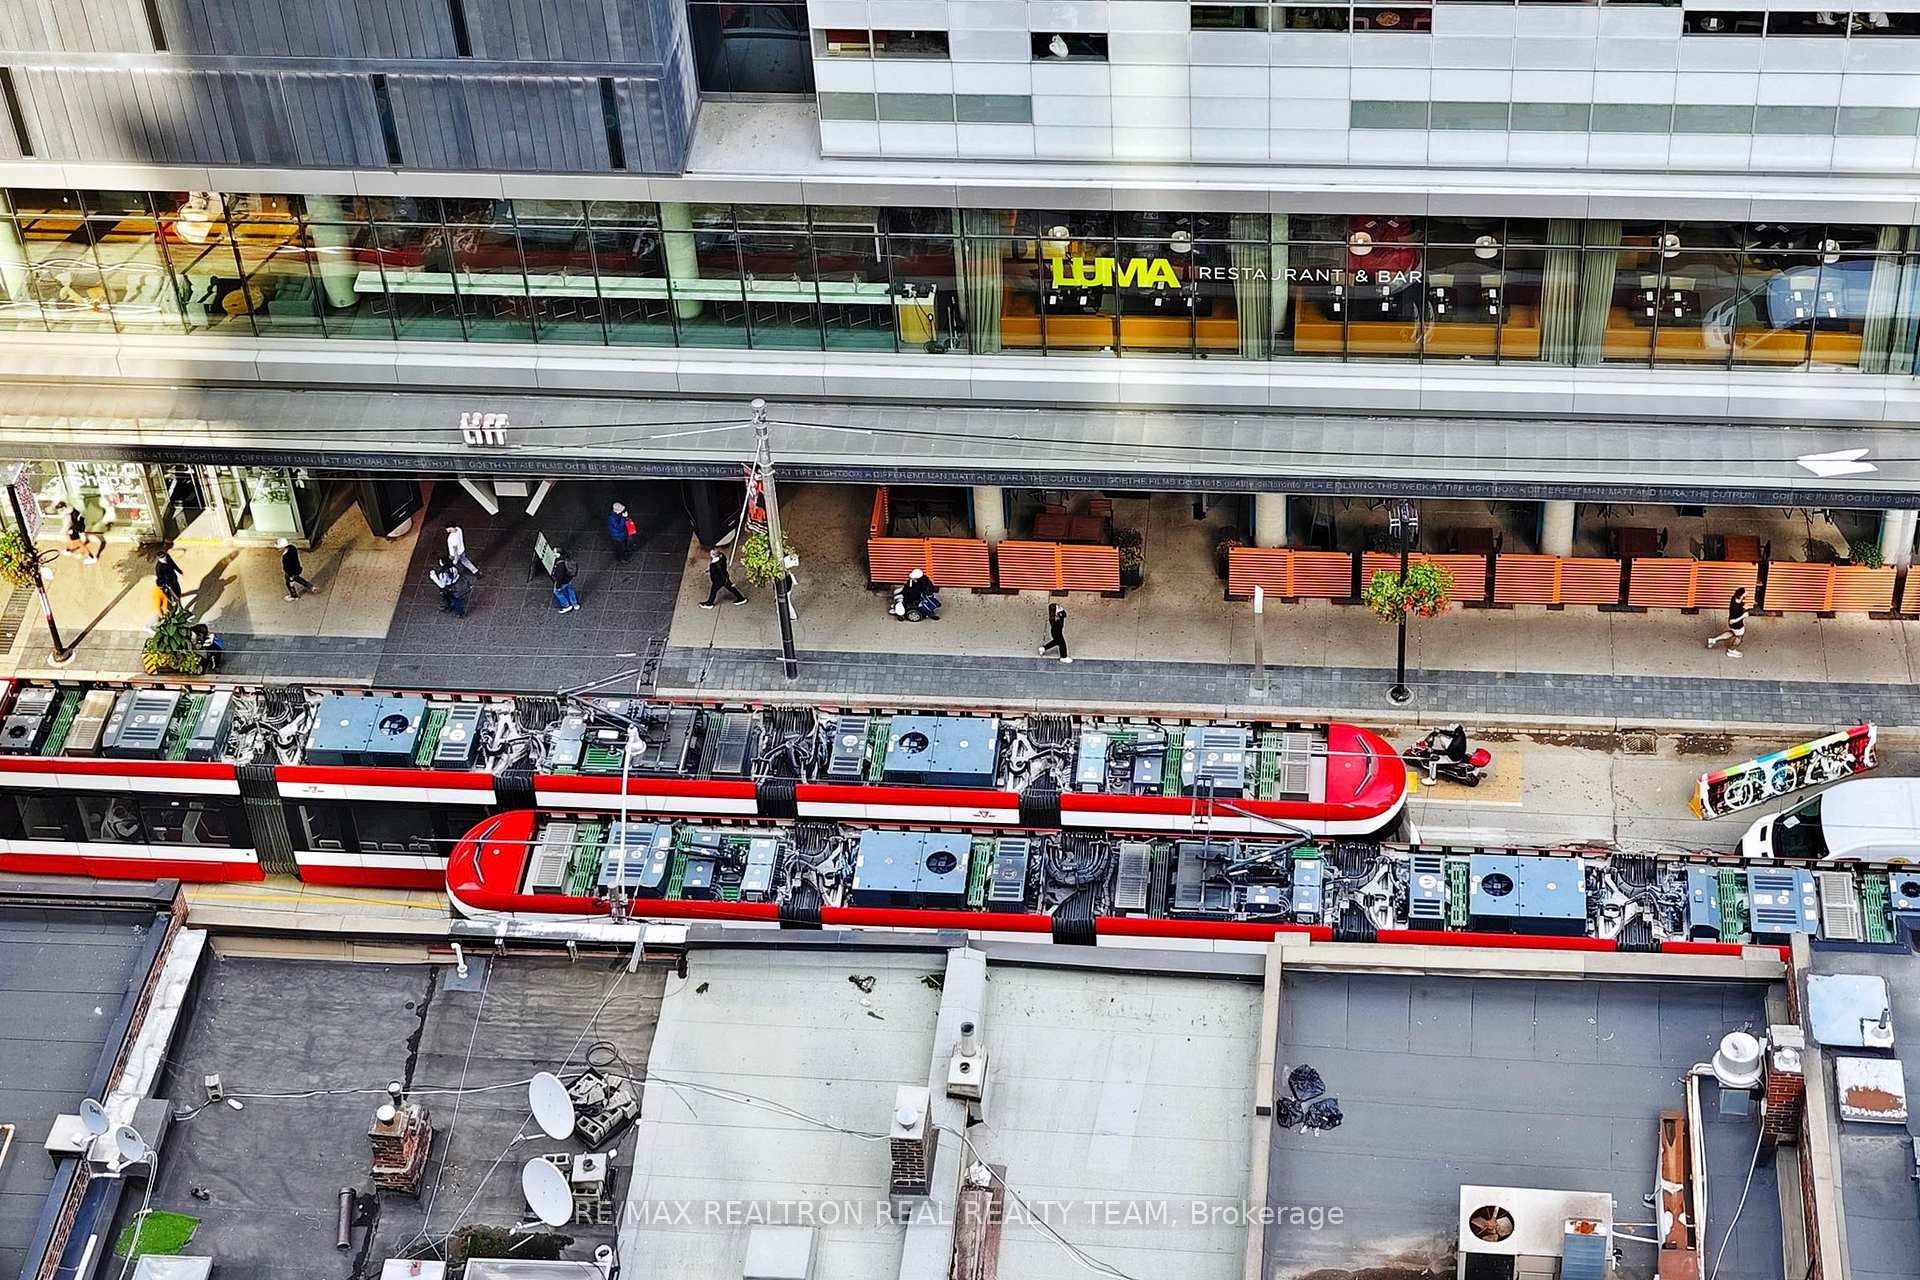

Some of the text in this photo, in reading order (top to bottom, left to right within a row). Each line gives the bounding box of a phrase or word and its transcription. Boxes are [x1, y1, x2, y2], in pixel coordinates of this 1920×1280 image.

[1052, 256, 1422, 288] LUMA RESTAURANT & BAR
[460, 411, 508, 445] tiff
